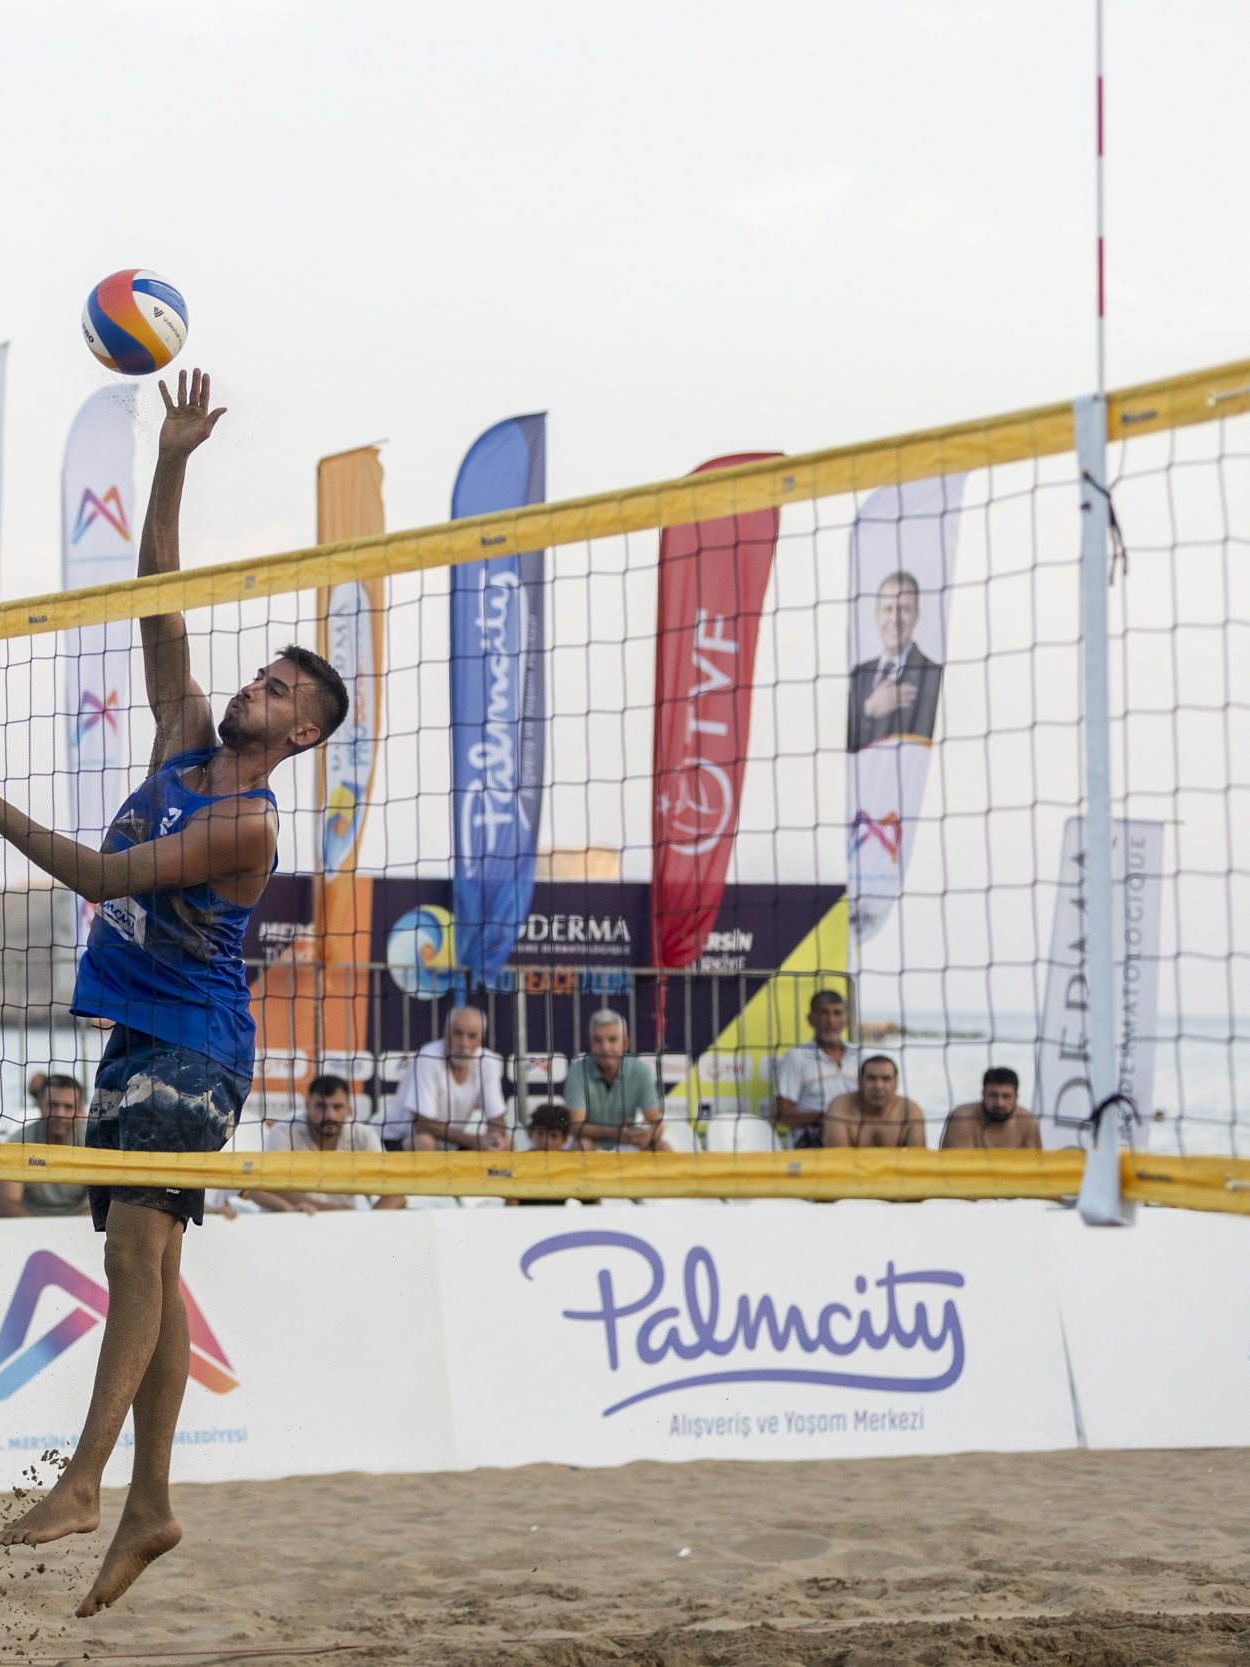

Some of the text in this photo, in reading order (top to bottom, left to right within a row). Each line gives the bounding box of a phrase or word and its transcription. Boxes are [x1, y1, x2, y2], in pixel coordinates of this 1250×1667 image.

[461, 568, 530, 878] Palmcity
[685, 608, 739, 746] TVF
[520, 1230, 965, 1417] Palmcity
[7, 1434, 66, 1450] MERSİN
[669, 1407, 925, 1439] Alışveriş ve Yaşam Merkezi
